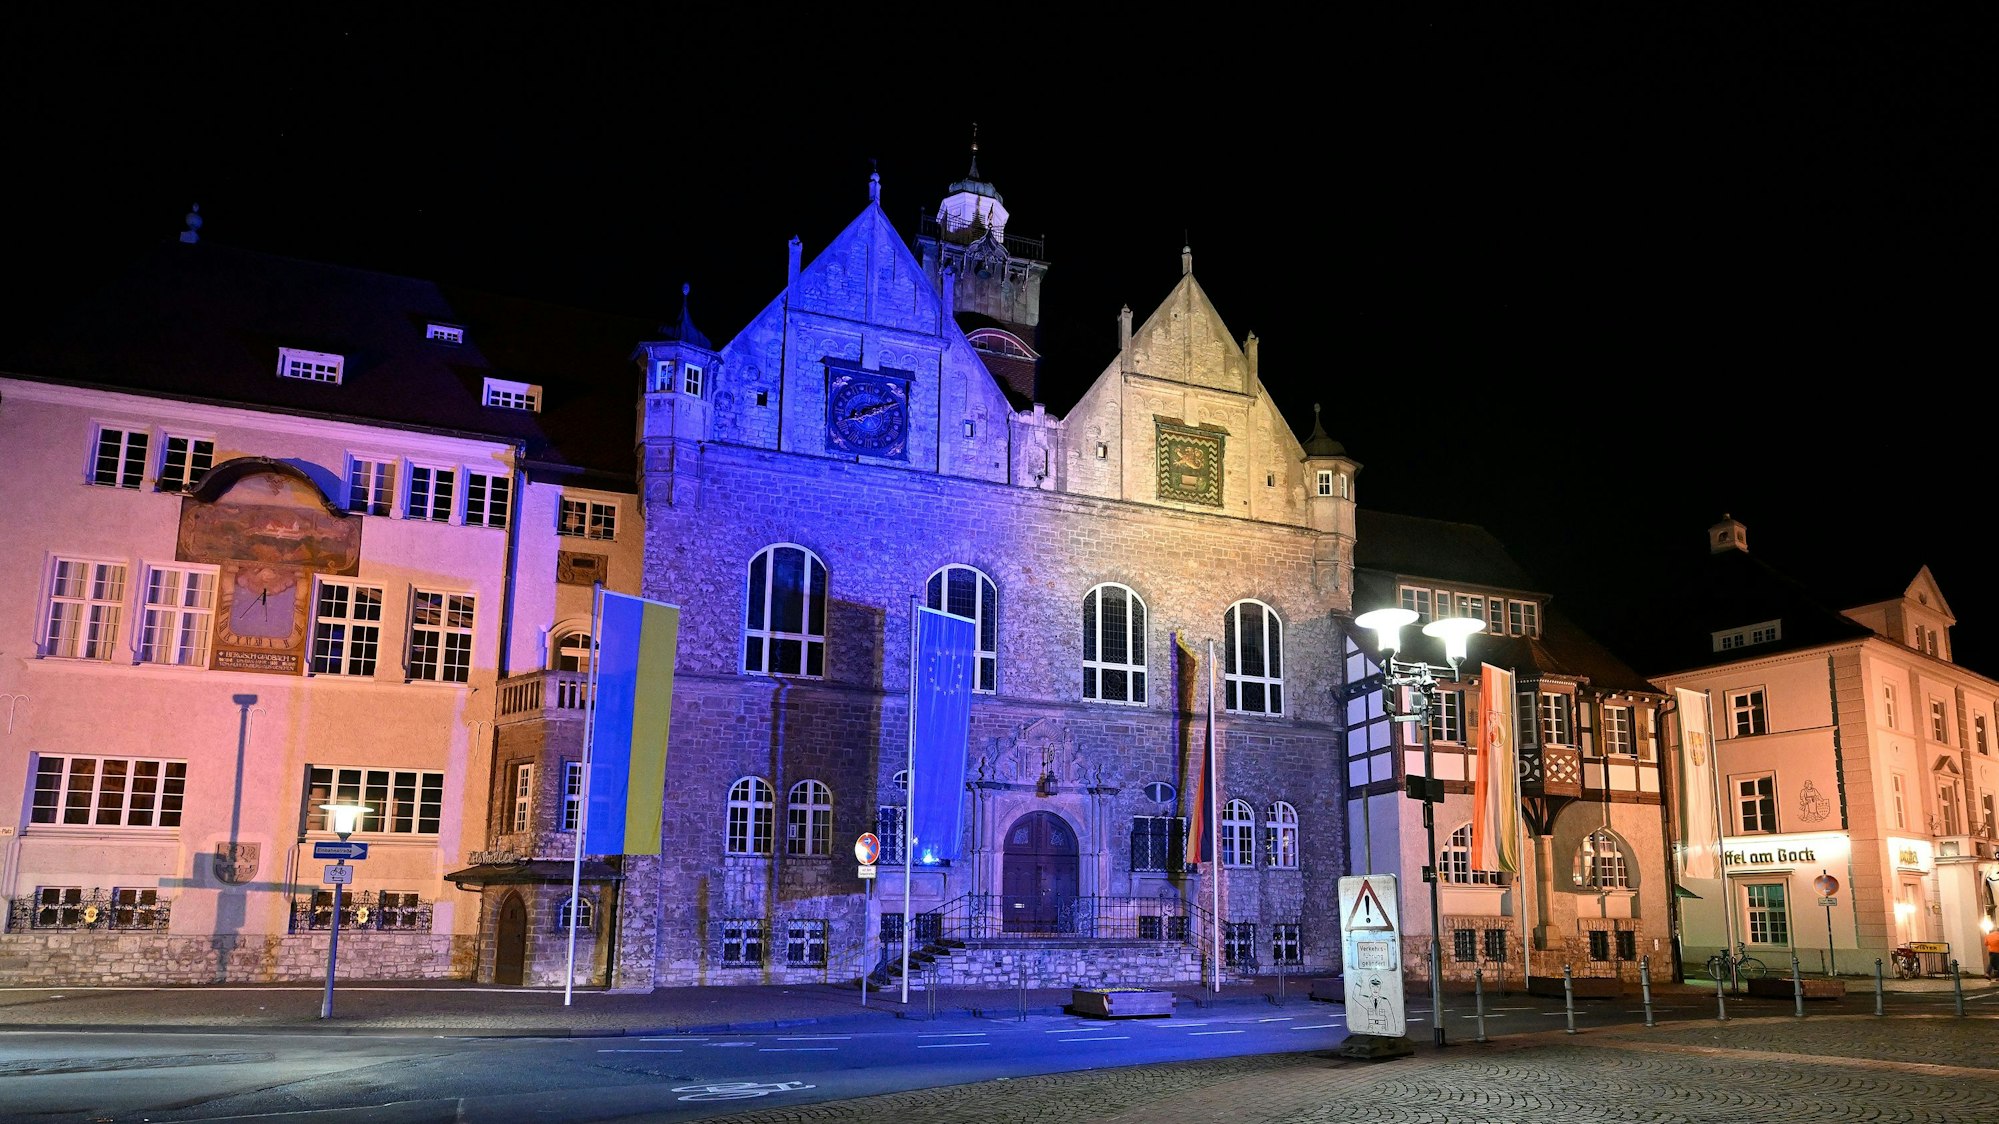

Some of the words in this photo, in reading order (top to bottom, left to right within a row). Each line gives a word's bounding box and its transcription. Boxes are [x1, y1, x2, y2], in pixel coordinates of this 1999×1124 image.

[1724, 850, 1747, 865] ffel
[1750, 852, 1774, 864] am
[1778, 847, 1816, 863] Bock
